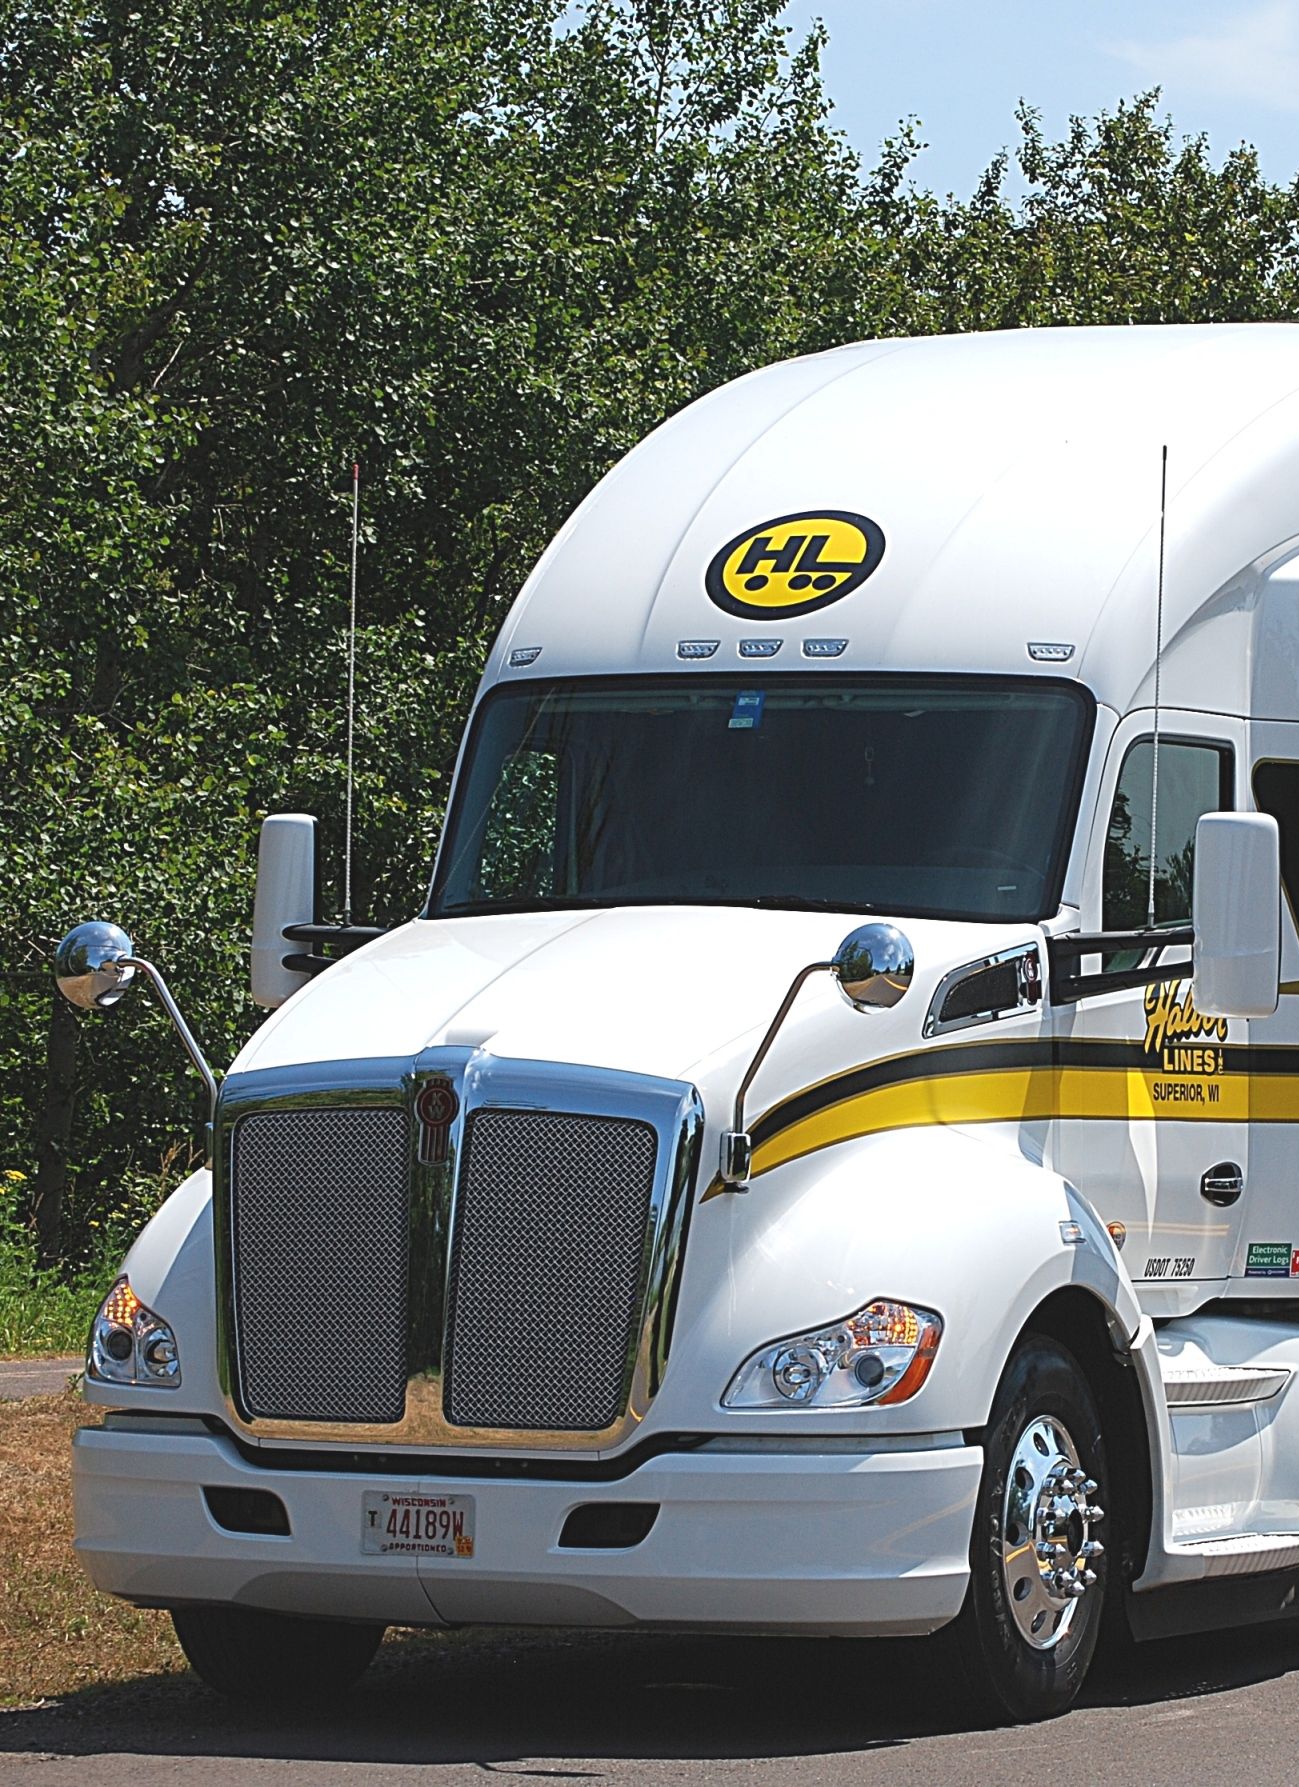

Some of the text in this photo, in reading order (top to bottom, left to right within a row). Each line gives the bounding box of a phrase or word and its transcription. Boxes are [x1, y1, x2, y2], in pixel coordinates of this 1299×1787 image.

[736, 535, 862, 574] HL
[1163, 1049, 1216, 1073] LINES
[1153, 1083, 1220, 1105] SUPERIOR, WI
[1252, 1245, 1288, 1254] Electronic
[1144, 1257, 1196, 1277] USDOT 75250
[1249, 1255, 1289, 1265] Driver Logs
[392, 1497, 447, 1508] WISCONSIN
[368, 1508, 464, 1541] T 44189W
[389, 1542, 447, 1553] APPORTIONED
